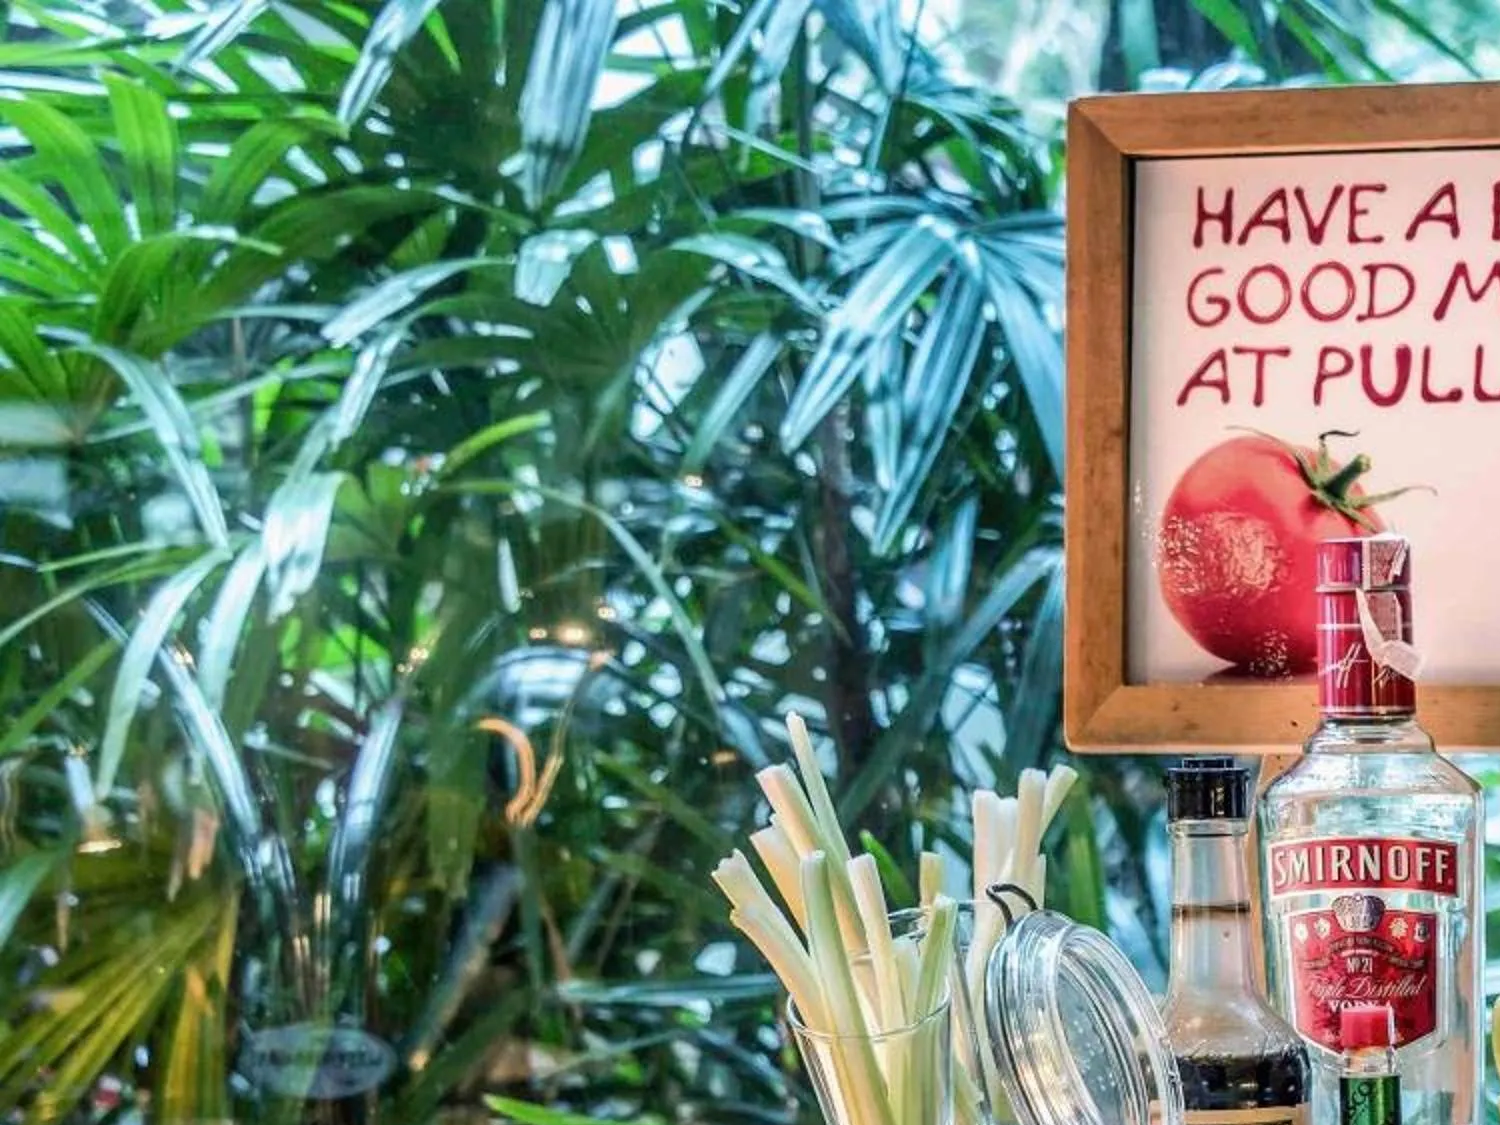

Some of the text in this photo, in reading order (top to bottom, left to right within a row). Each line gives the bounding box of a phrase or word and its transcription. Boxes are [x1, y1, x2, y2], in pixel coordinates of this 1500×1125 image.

[1191, 181, 1388, 248] HAVE
[1405, 181, 1461, 240] A
[1186, 260, 1416, 328] GOOD
[1176, 344, 1293, 408] AT
[1274, 845, 1450, 887] SMIRNOFF
